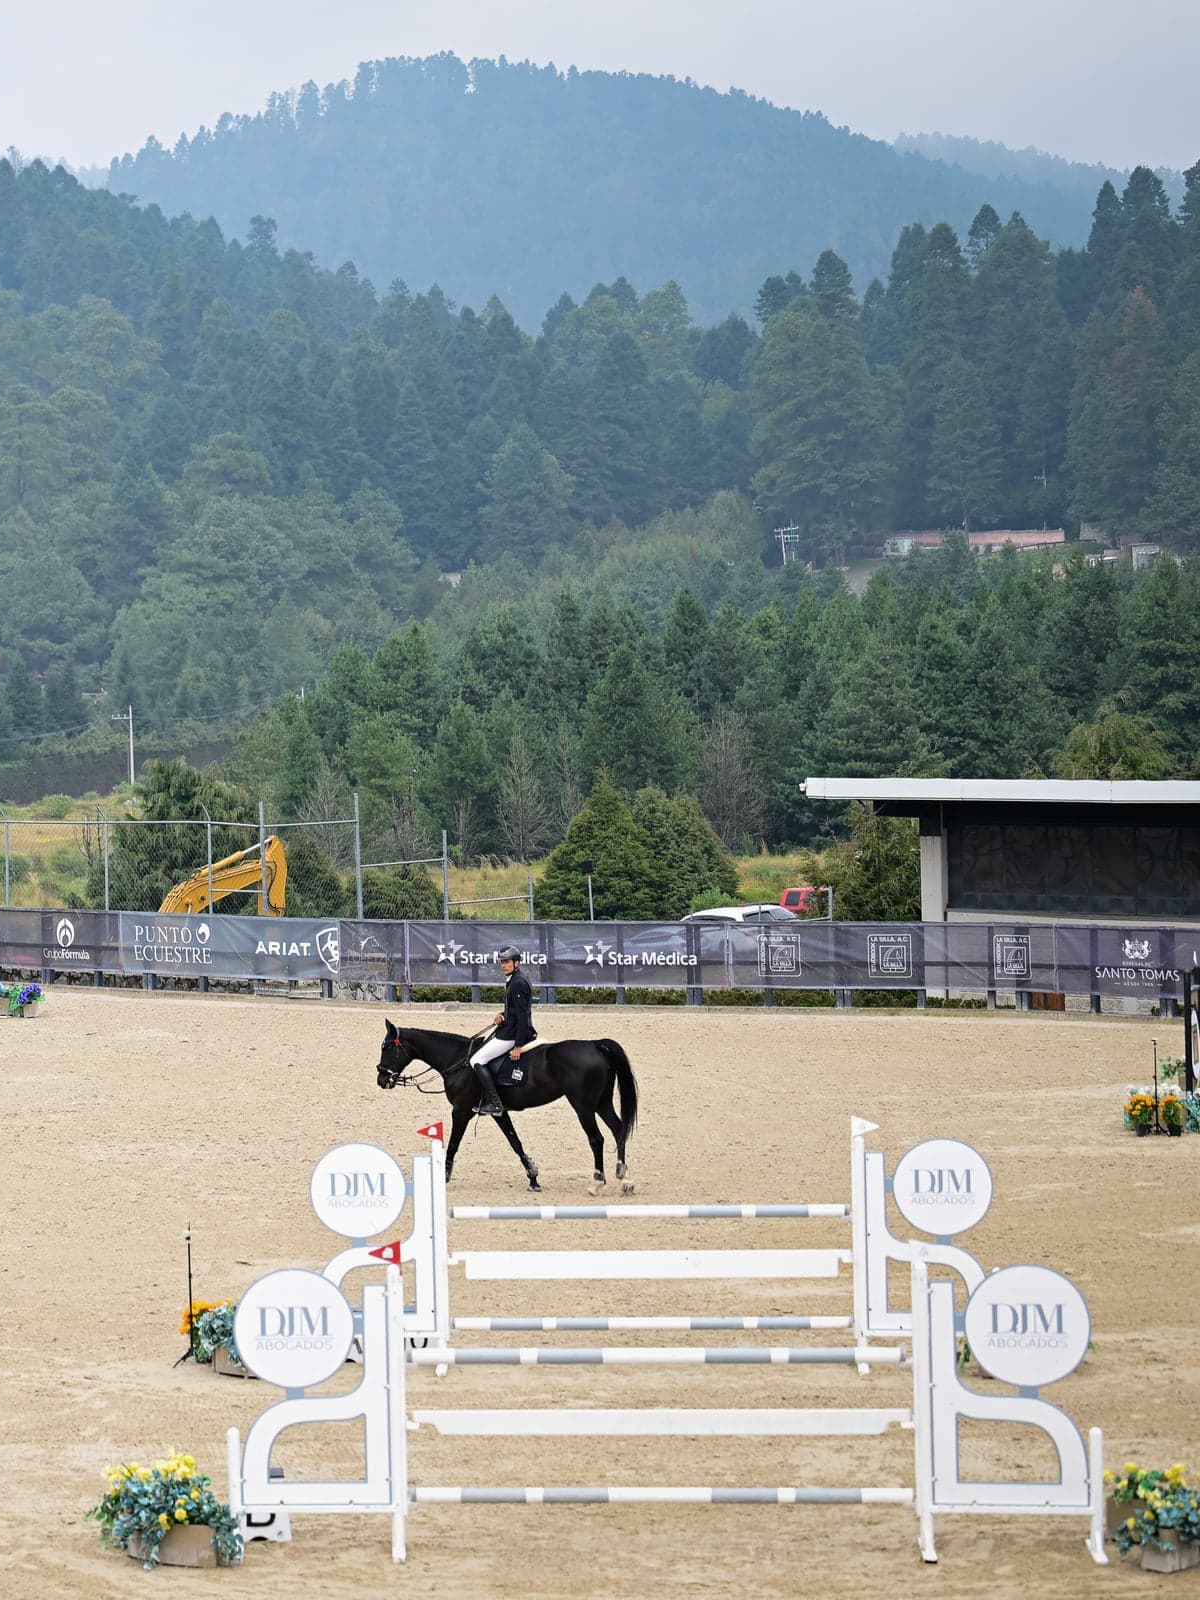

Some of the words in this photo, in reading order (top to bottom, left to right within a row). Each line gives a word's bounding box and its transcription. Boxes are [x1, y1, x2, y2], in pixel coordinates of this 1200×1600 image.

[135, 925, 192, 944] PUNTO
[43, 947, 90, 960] GrupoFórmula
[134, 945, 213, 964] ECUESTRE
[460, 950, 489, 964] Star
[608, 951, 636, 966] Star
[642, 951, 697, 966] Médica
[1095, 966, 1136, 979] SANTO
[329, 1173, 389, 1197] DJM
[912, 1169, 974, 1193] DJM
[328, 1200, 389, 1208] ABOGADOS
[256, 1306, 333, 1337] DJM
[987, 1303, 1067, 1334] DJM
[256, 1341, 333, 1351] ABOGADOS
[987, 1338, 1068, 1348] ABOGADOS
